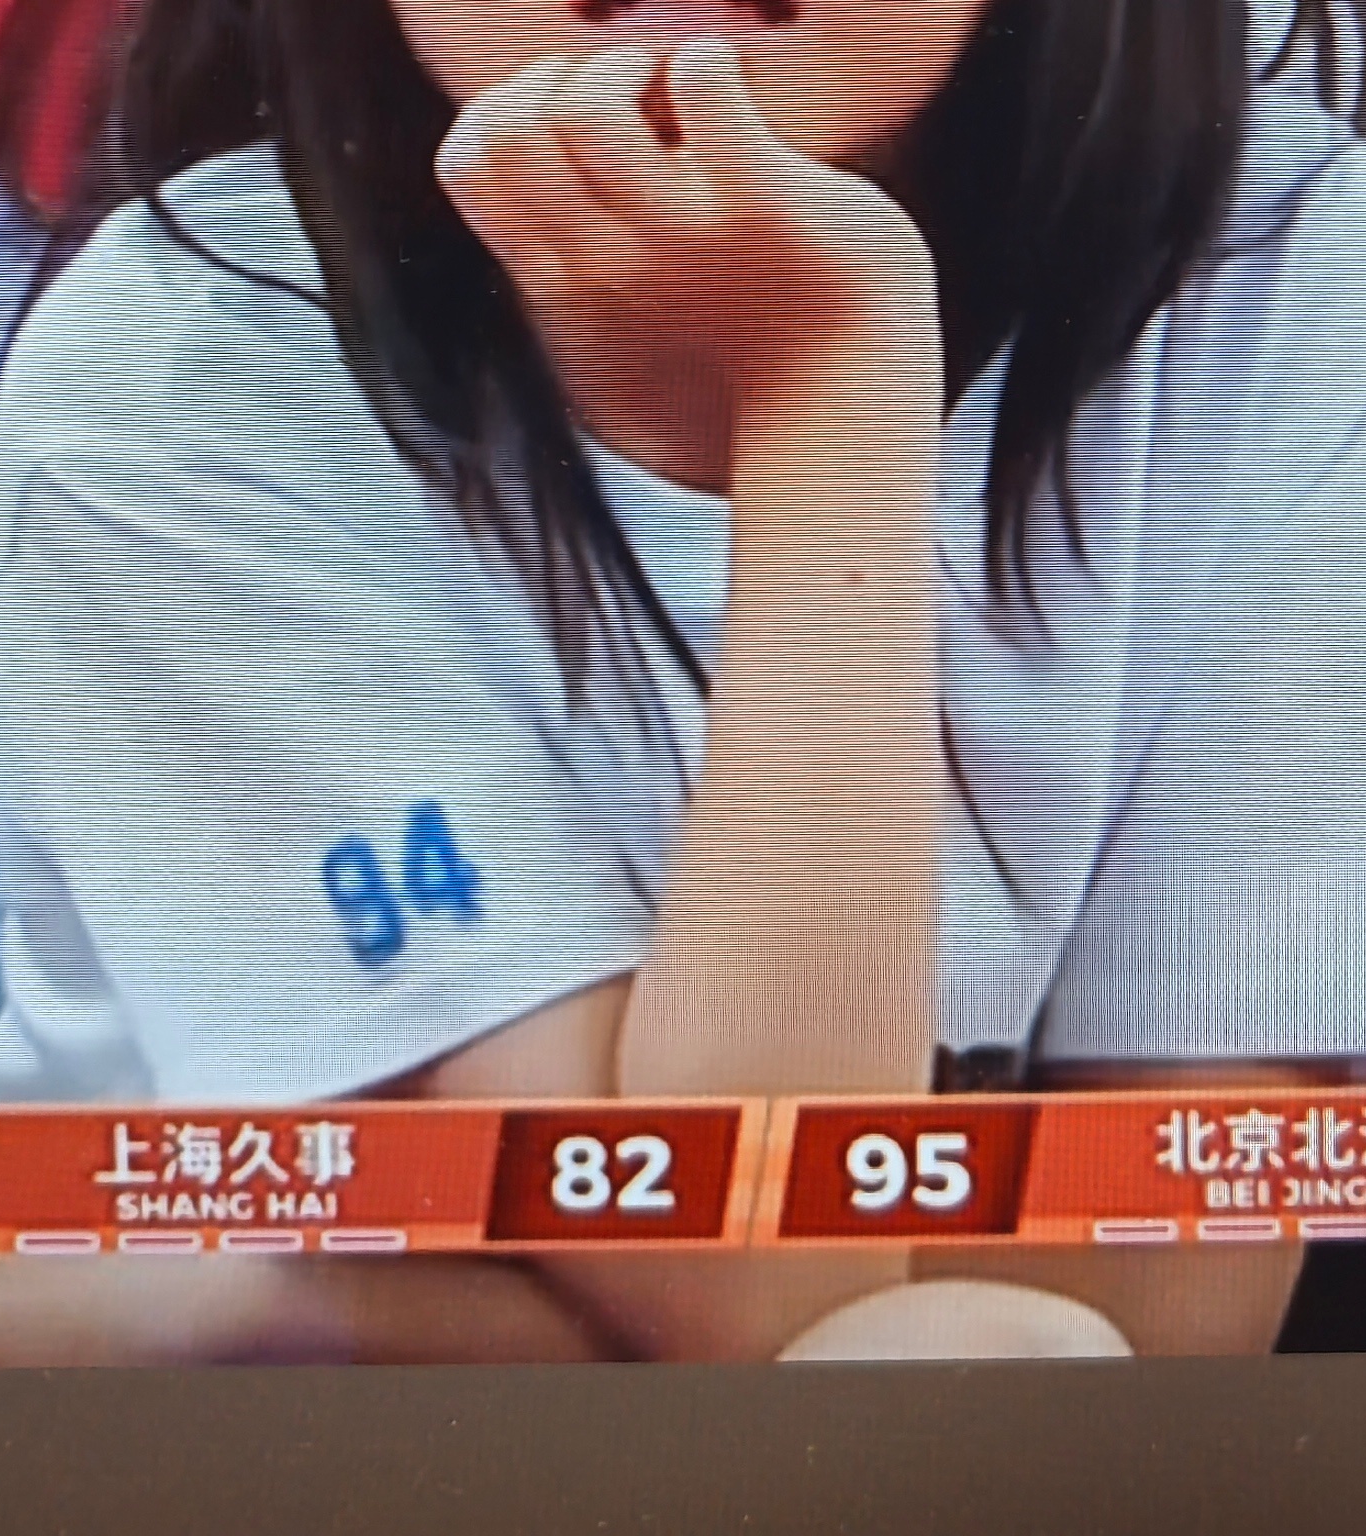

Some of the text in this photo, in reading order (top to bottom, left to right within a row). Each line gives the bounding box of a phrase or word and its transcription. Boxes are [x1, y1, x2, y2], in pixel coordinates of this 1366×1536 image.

[321, 796, 486, 968] 94
[92, 1120, 357, 1186] 上海久事
[550, 1134, 677, 1212] 82
[844, 1133, 974, 1211] 95
[116, 1191, 339, 1222] SHANG HAI
[1205, 1177, 1271, 1209] BEI
